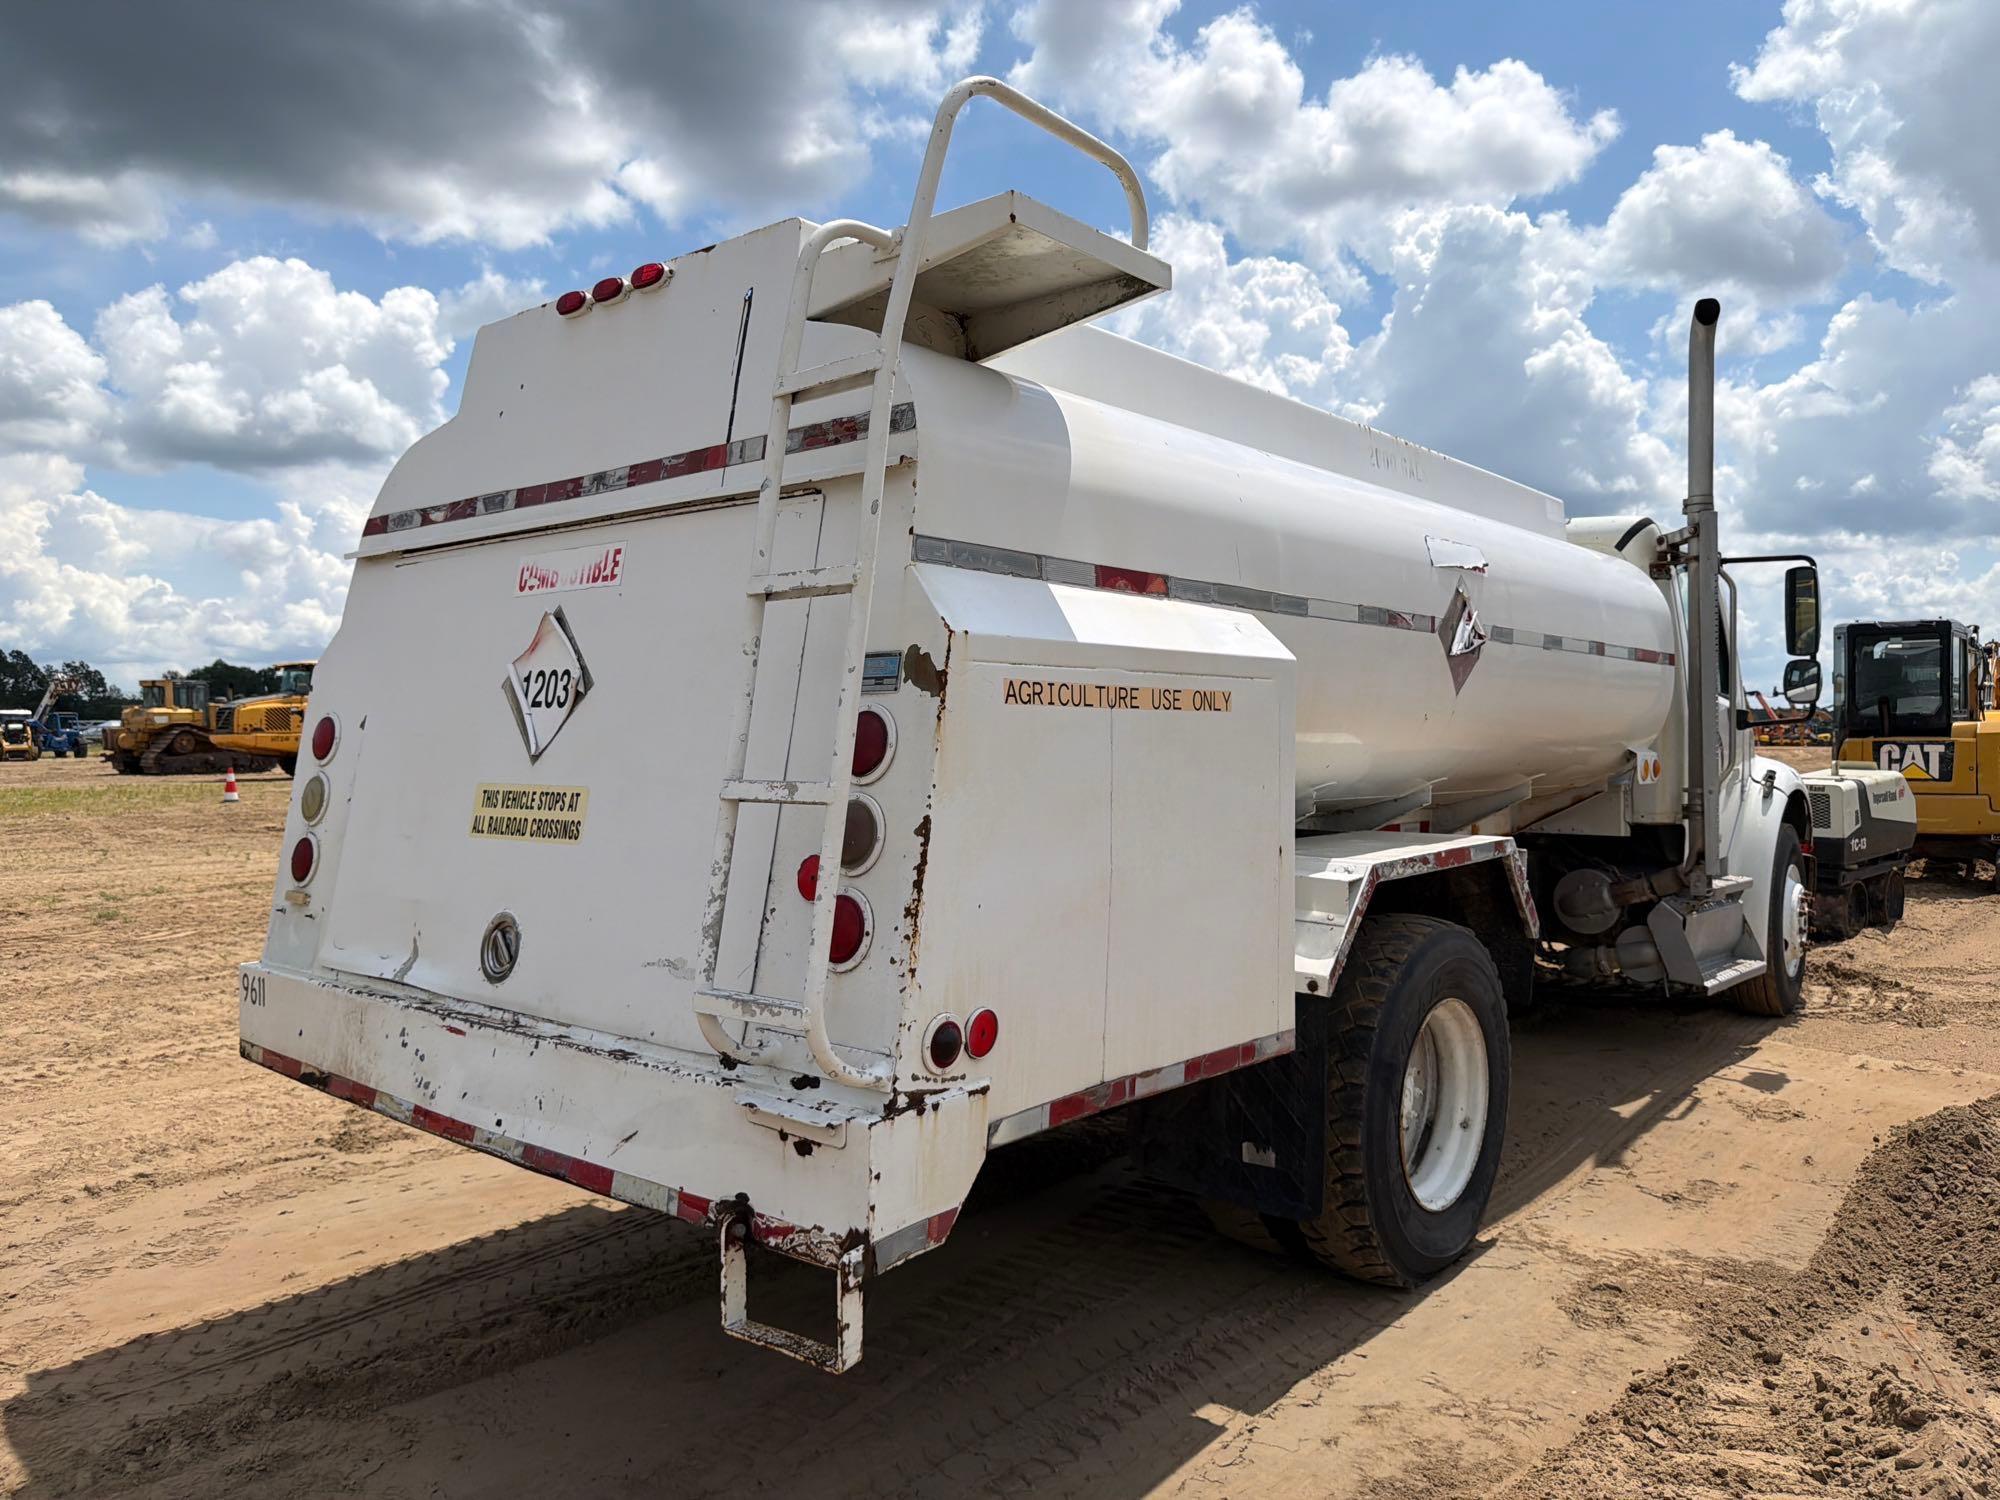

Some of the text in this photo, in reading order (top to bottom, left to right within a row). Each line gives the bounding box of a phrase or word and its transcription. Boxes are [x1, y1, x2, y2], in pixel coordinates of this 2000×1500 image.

[518, 548, 622, 593] COMBTIBLE
[523, 669, 571, 709] 1203
[1004, 680, 1232, 712] AGRICULTURE USE ONLY
[1880, 743, 1945, 779] CAT
[481, 789, 581, 812] THIS VEHICLE STOPS AT
[471, 815, 581, 841] ALL RAILROAD CROSSINGS
[241, 972, 266, 1007] 9611
